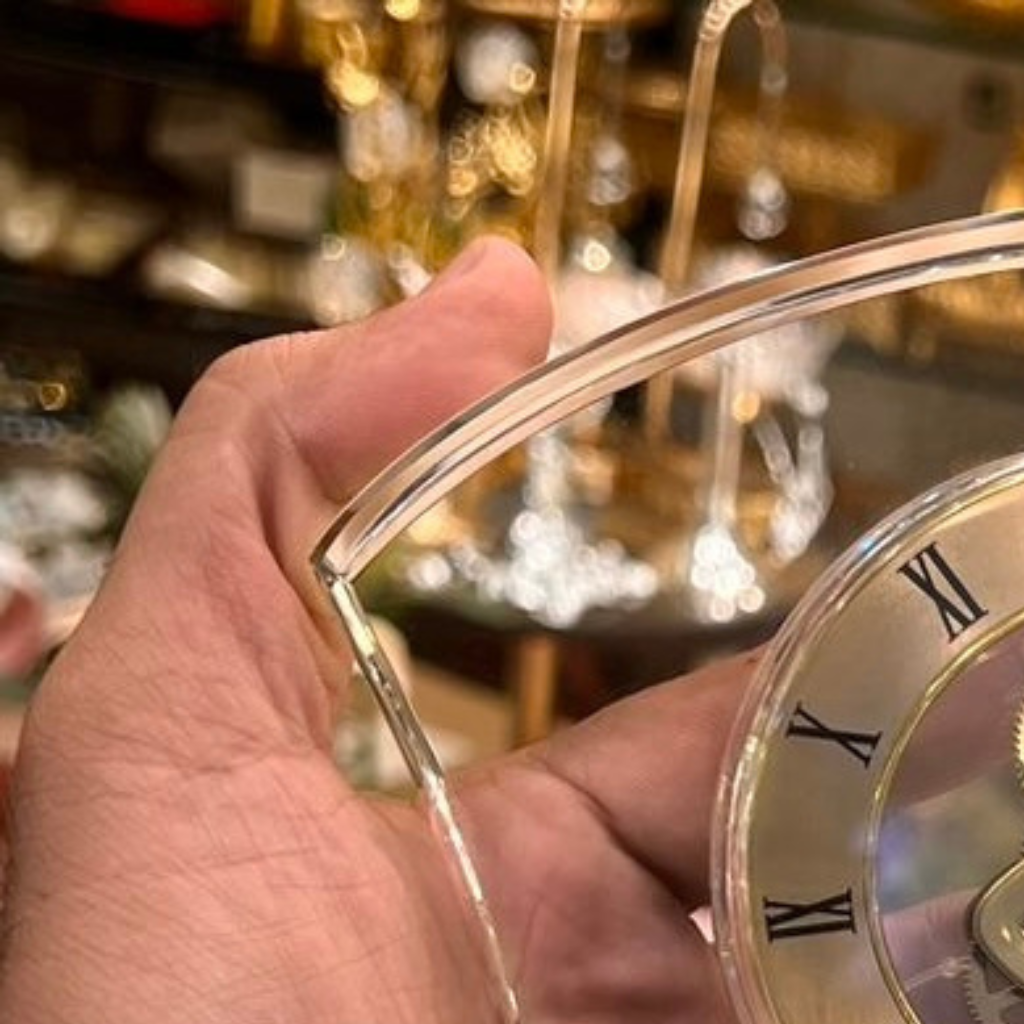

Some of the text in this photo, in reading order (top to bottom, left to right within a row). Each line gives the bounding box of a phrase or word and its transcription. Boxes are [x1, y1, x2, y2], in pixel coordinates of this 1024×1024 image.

[897, 542, 989, 642] XI
[786, 706, 883, 768] X
[764, 888, 857, 943] IX
